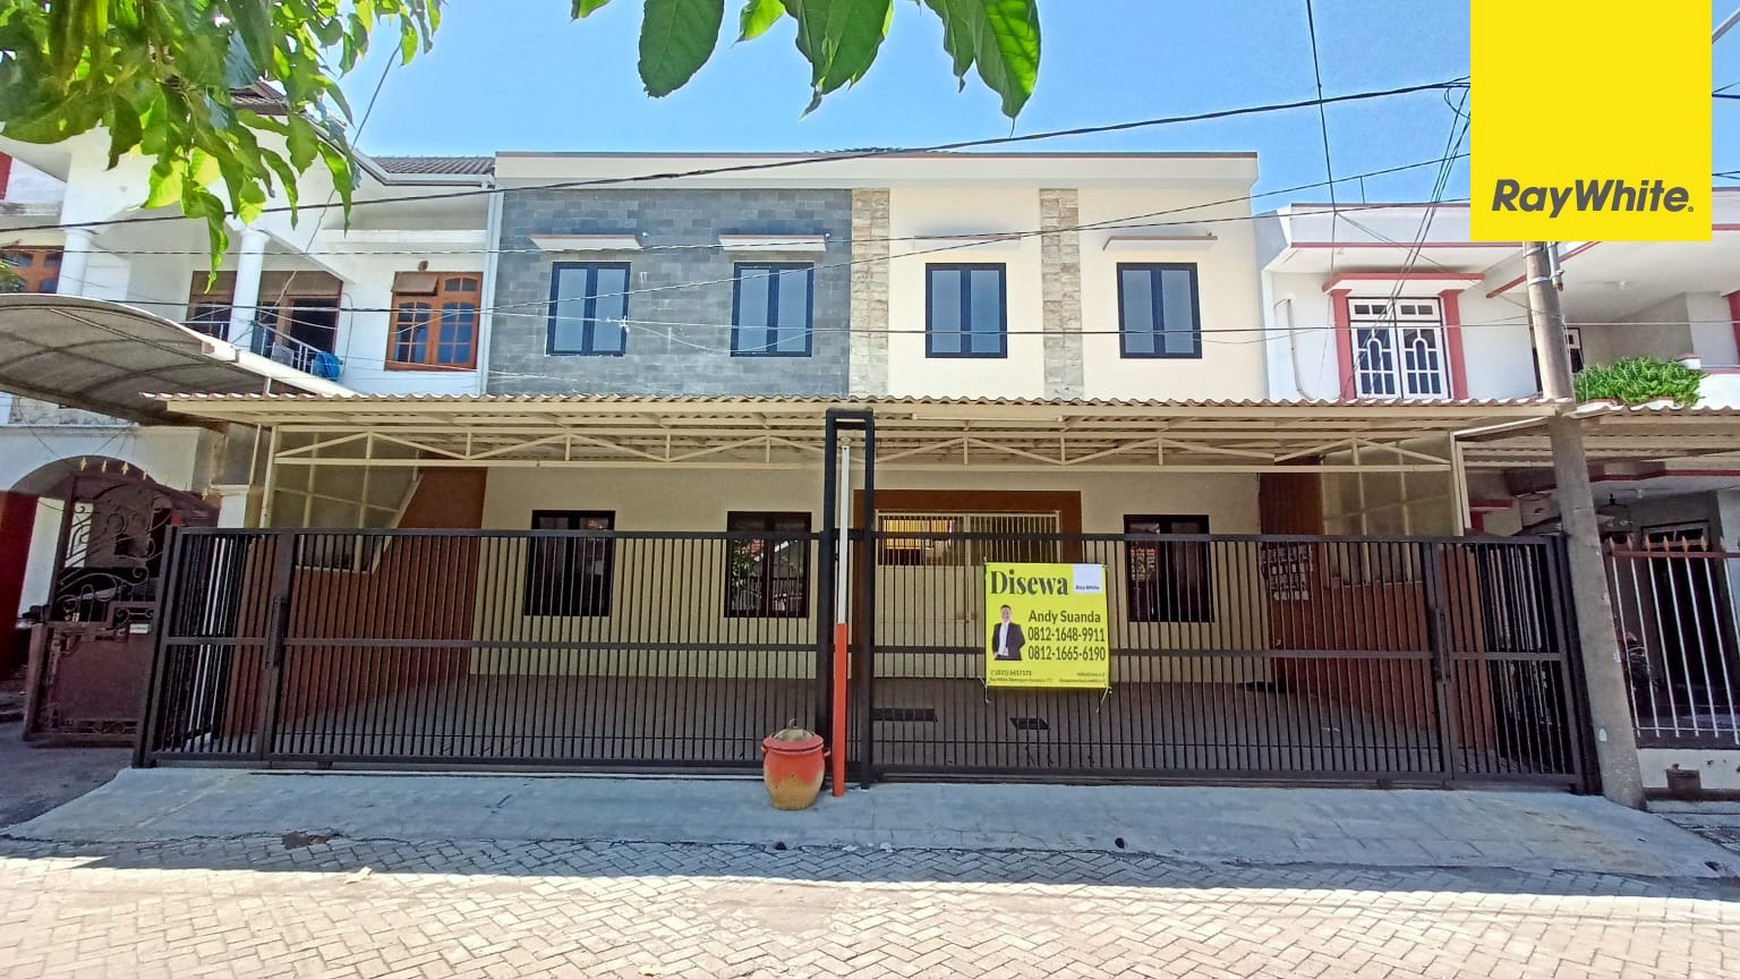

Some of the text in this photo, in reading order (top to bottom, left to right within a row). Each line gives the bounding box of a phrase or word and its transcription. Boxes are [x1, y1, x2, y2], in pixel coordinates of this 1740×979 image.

[990, 569, 1069, 595] Disewa
[1028, 609, 1101, 624] Andy Suanda
[1027, 626, 1105, 642] 0812-1648-9911
[1027, 645, 1106, 661] 0812-1665-6190
